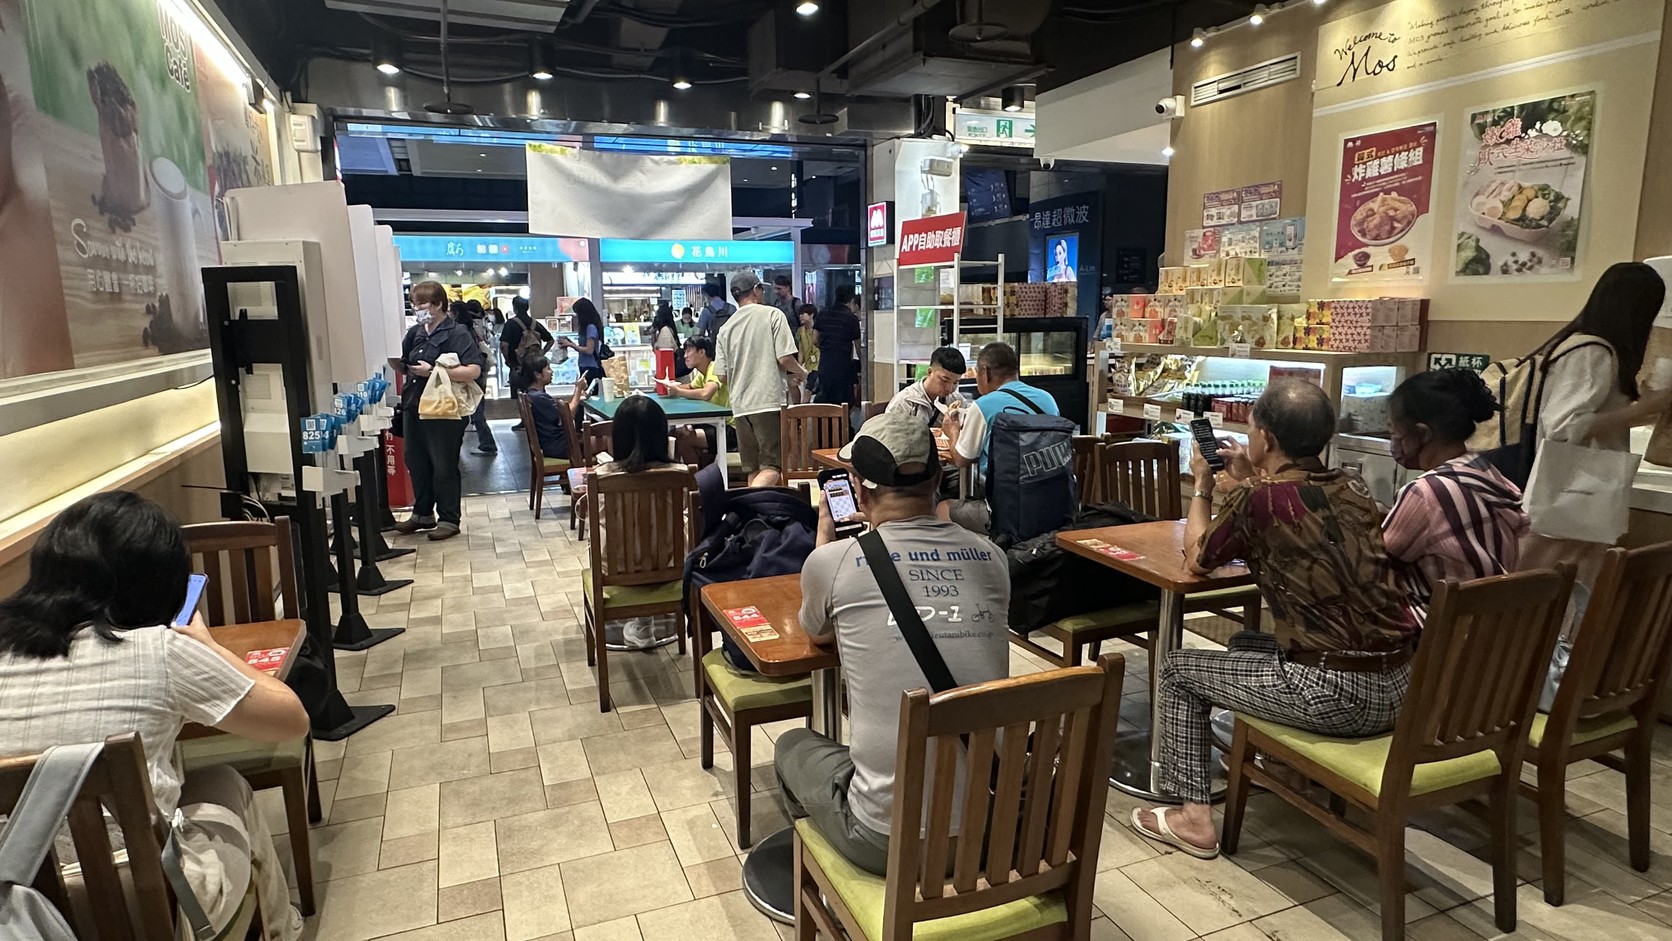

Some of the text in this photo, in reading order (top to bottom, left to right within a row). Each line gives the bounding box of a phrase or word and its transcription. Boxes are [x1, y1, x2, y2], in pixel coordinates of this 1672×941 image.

[1333, 31, 1401, 61] Welcome to
[1336, 45, 1398, 87] Mos
[908, 549, 941, 562] und
[946, 549, 992, 562] müller
[908, 568, 965, 581] SINCE
[922, 584, 959, 598] 1993
